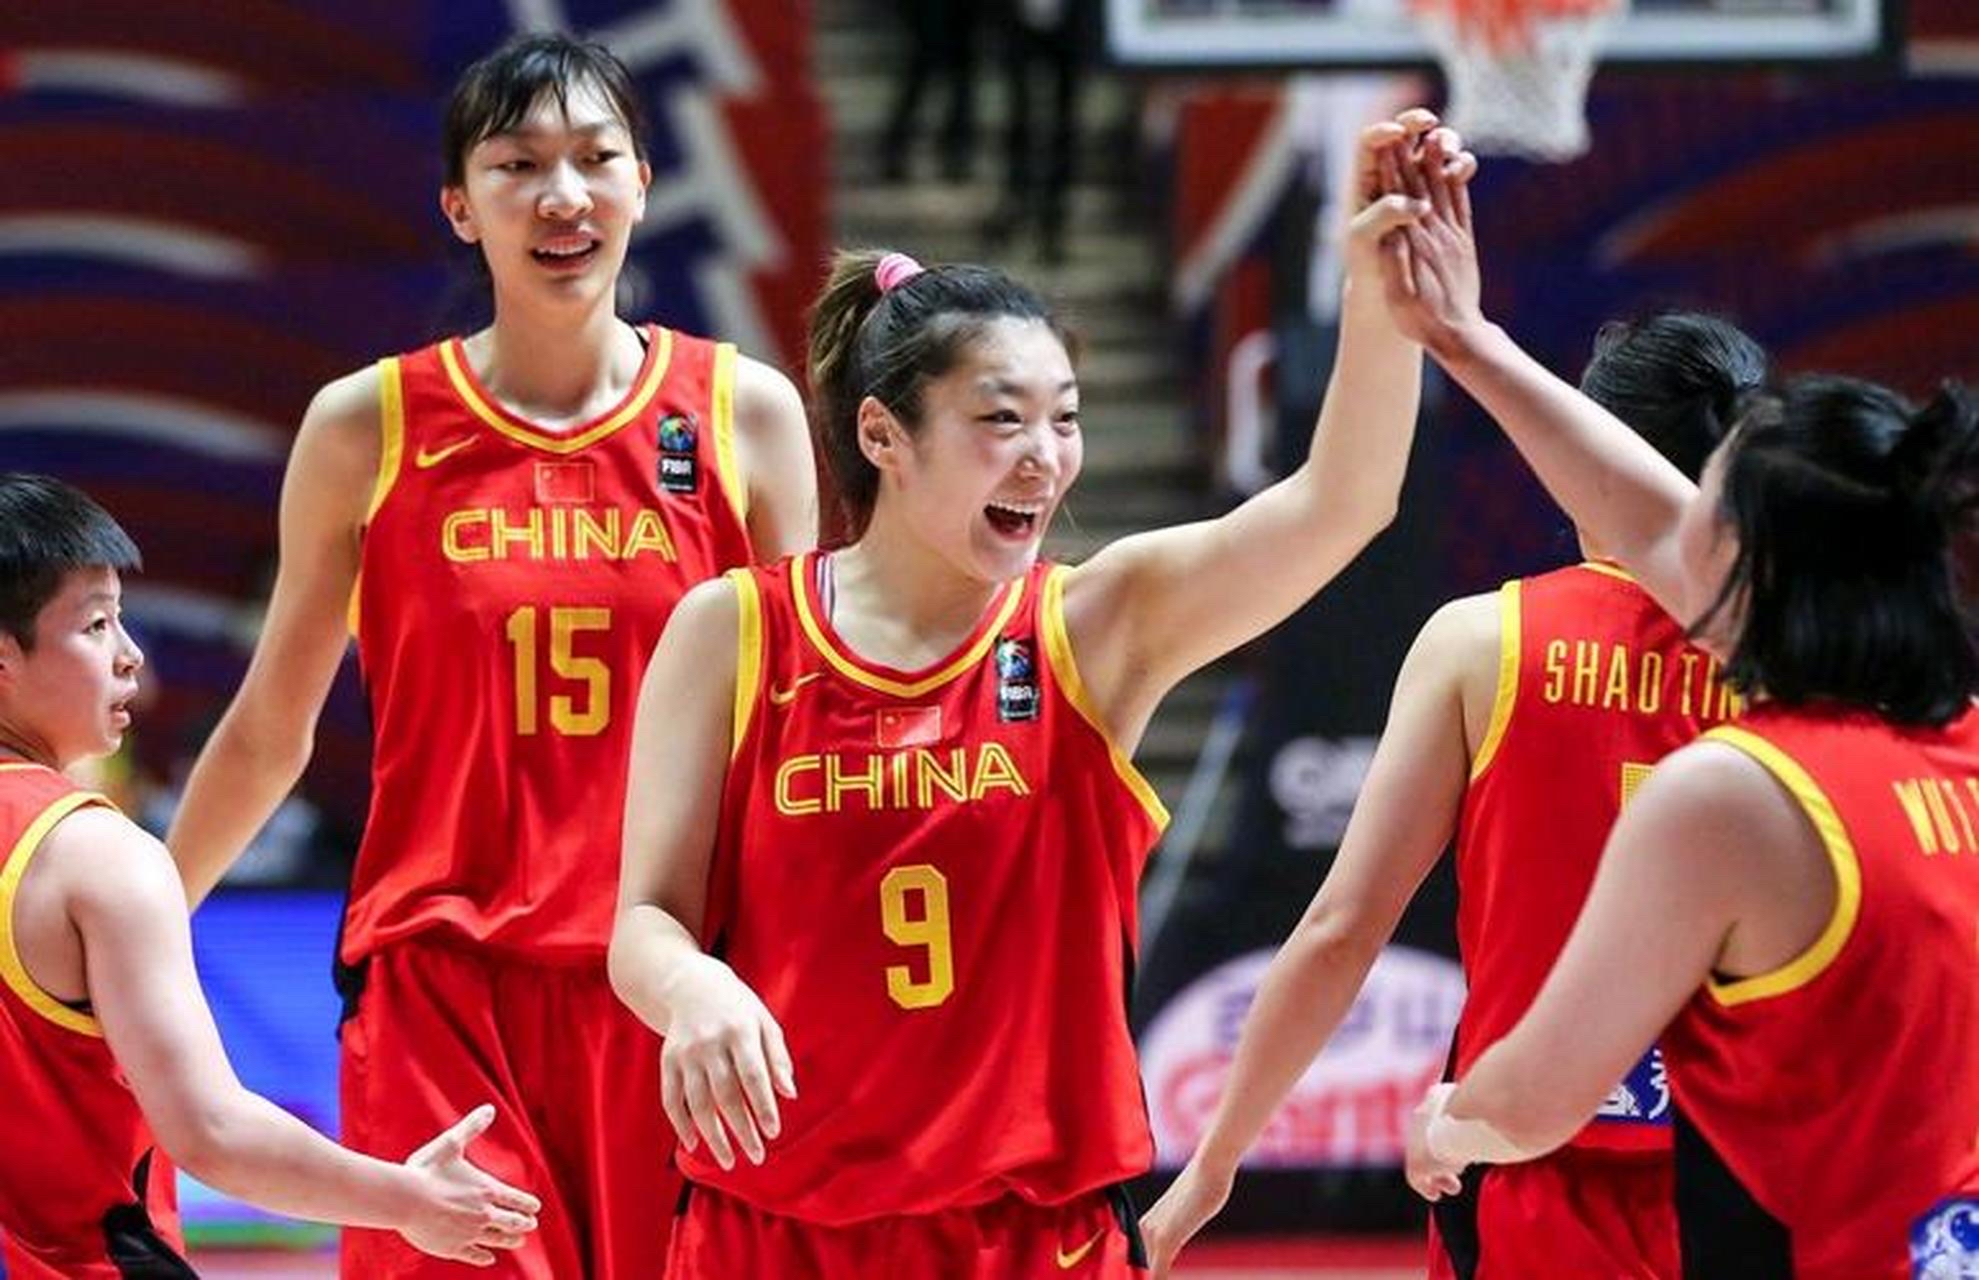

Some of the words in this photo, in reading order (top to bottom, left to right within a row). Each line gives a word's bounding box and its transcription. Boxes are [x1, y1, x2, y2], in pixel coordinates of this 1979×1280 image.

[443, 508, 677, 562] CHINA
[506, 605, 611, 736] 15
[1544, 639, 1662, 714] SHAO
[775, 742, 1030, 815] CHINA
[880, 863, 954, 1010] 9
